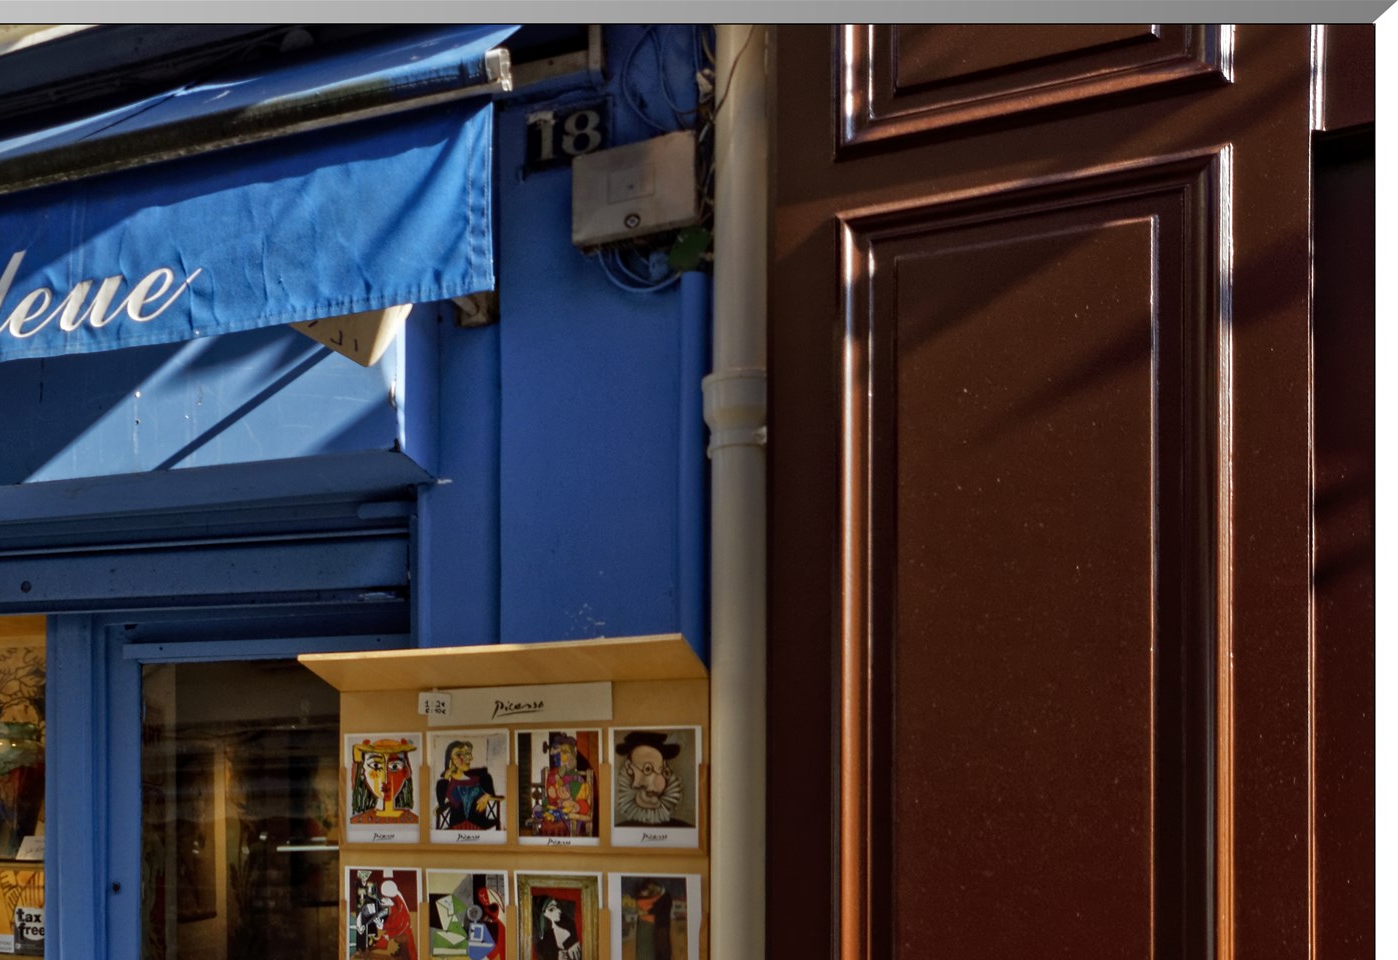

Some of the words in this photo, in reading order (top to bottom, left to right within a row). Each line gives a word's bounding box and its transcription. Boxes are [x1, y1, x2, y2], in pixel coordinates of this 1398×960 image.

[527, 109, 601, 160] 18
[491, 700, 545, 720] Picasso
[16, 908, 42, 923] tax
[18, 922, 45, 937] free
